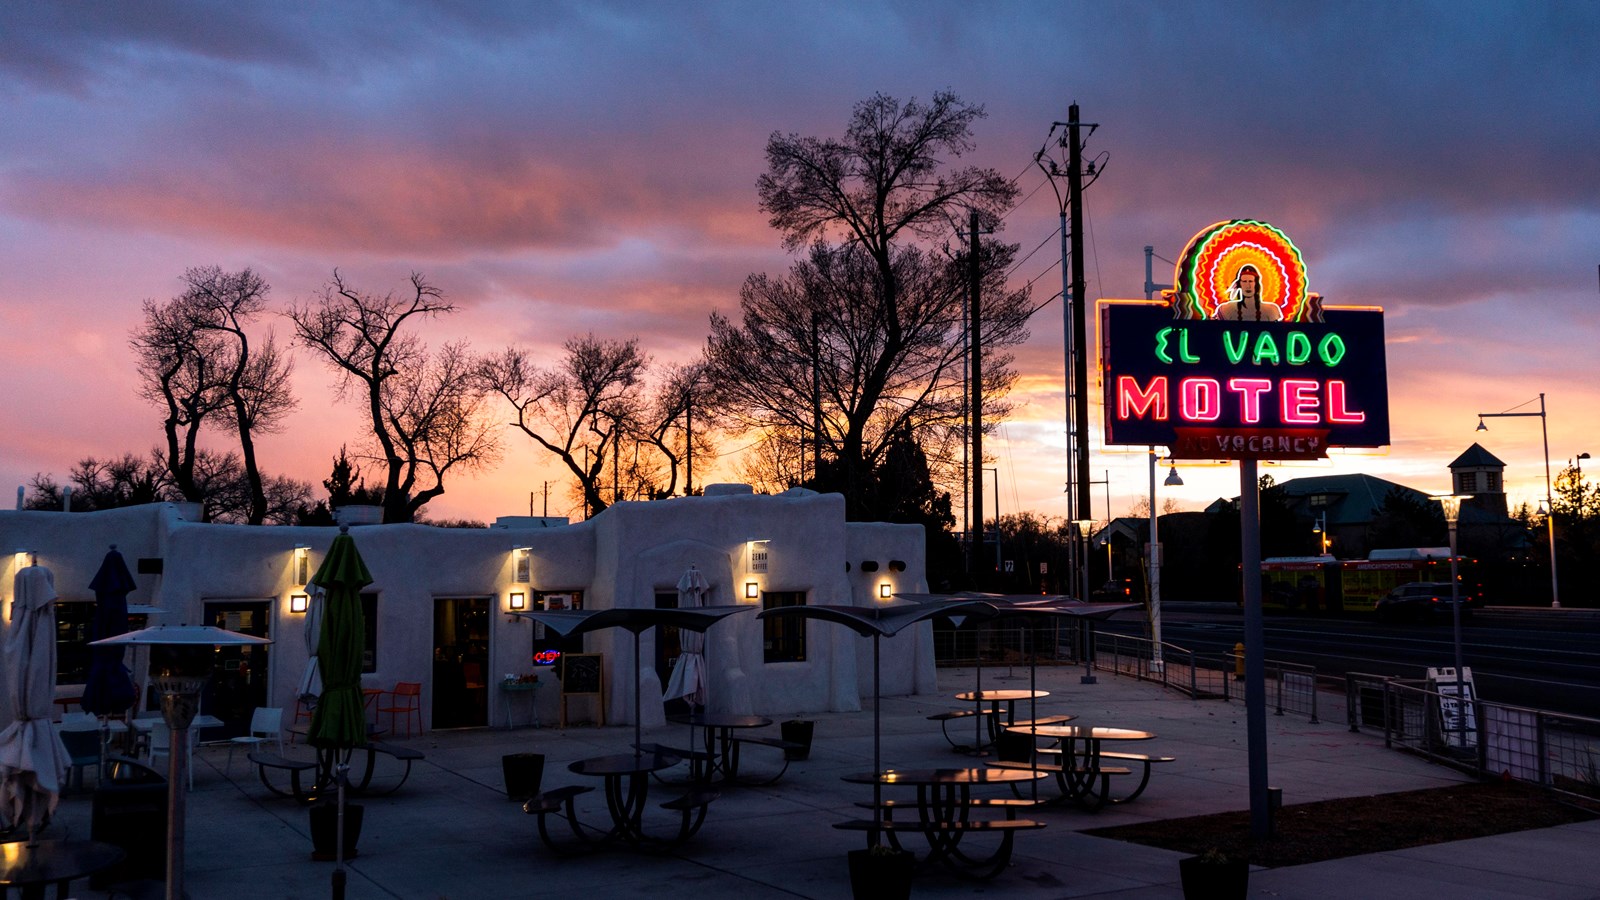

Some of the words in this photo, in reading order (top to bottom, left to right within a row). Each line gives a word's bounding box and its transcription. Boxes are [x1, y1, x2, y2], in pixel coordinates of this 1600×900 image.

[1155, 326, 1201, 364] EL
[1223, 330, 1345, 367] VADO
[1117, 375, 1366, 425] MOTEL
[1215, 434, 1320, 453] VACANCY
